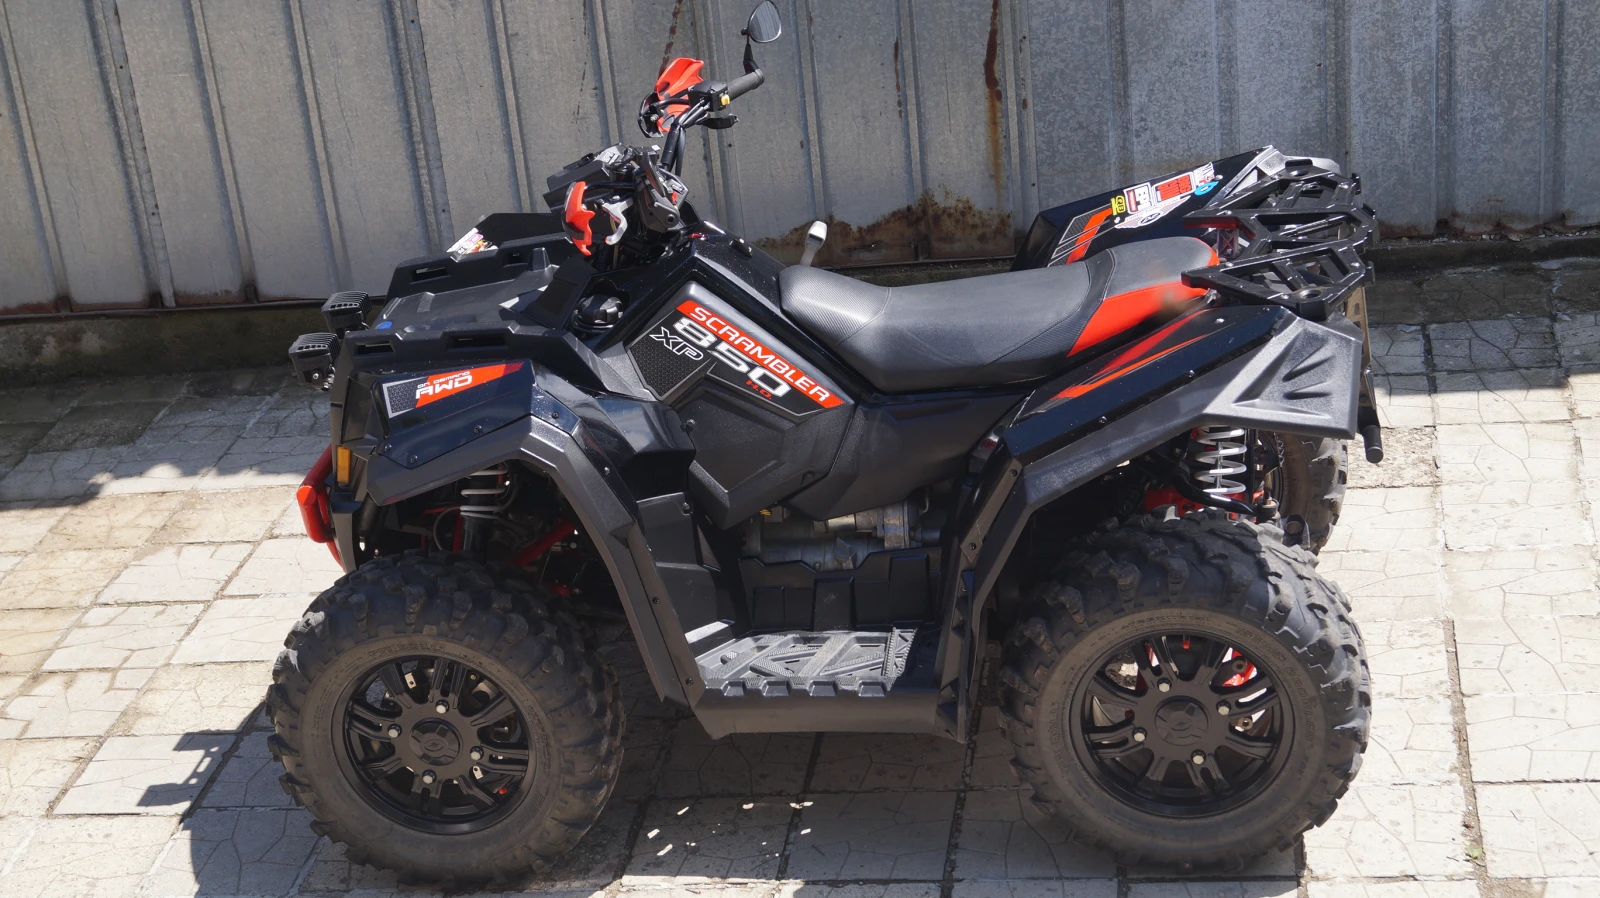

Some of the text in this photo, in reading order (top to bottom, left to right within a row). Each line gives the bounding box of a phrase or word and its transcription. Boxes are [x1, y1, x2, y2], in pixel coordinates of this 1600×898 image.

[649, 326, 704, 361] XP
[673, 316, 792, 398] 850
[690, 306, 831, 402] SCRAMBLER
[415, 375, 473, 400] AWD
